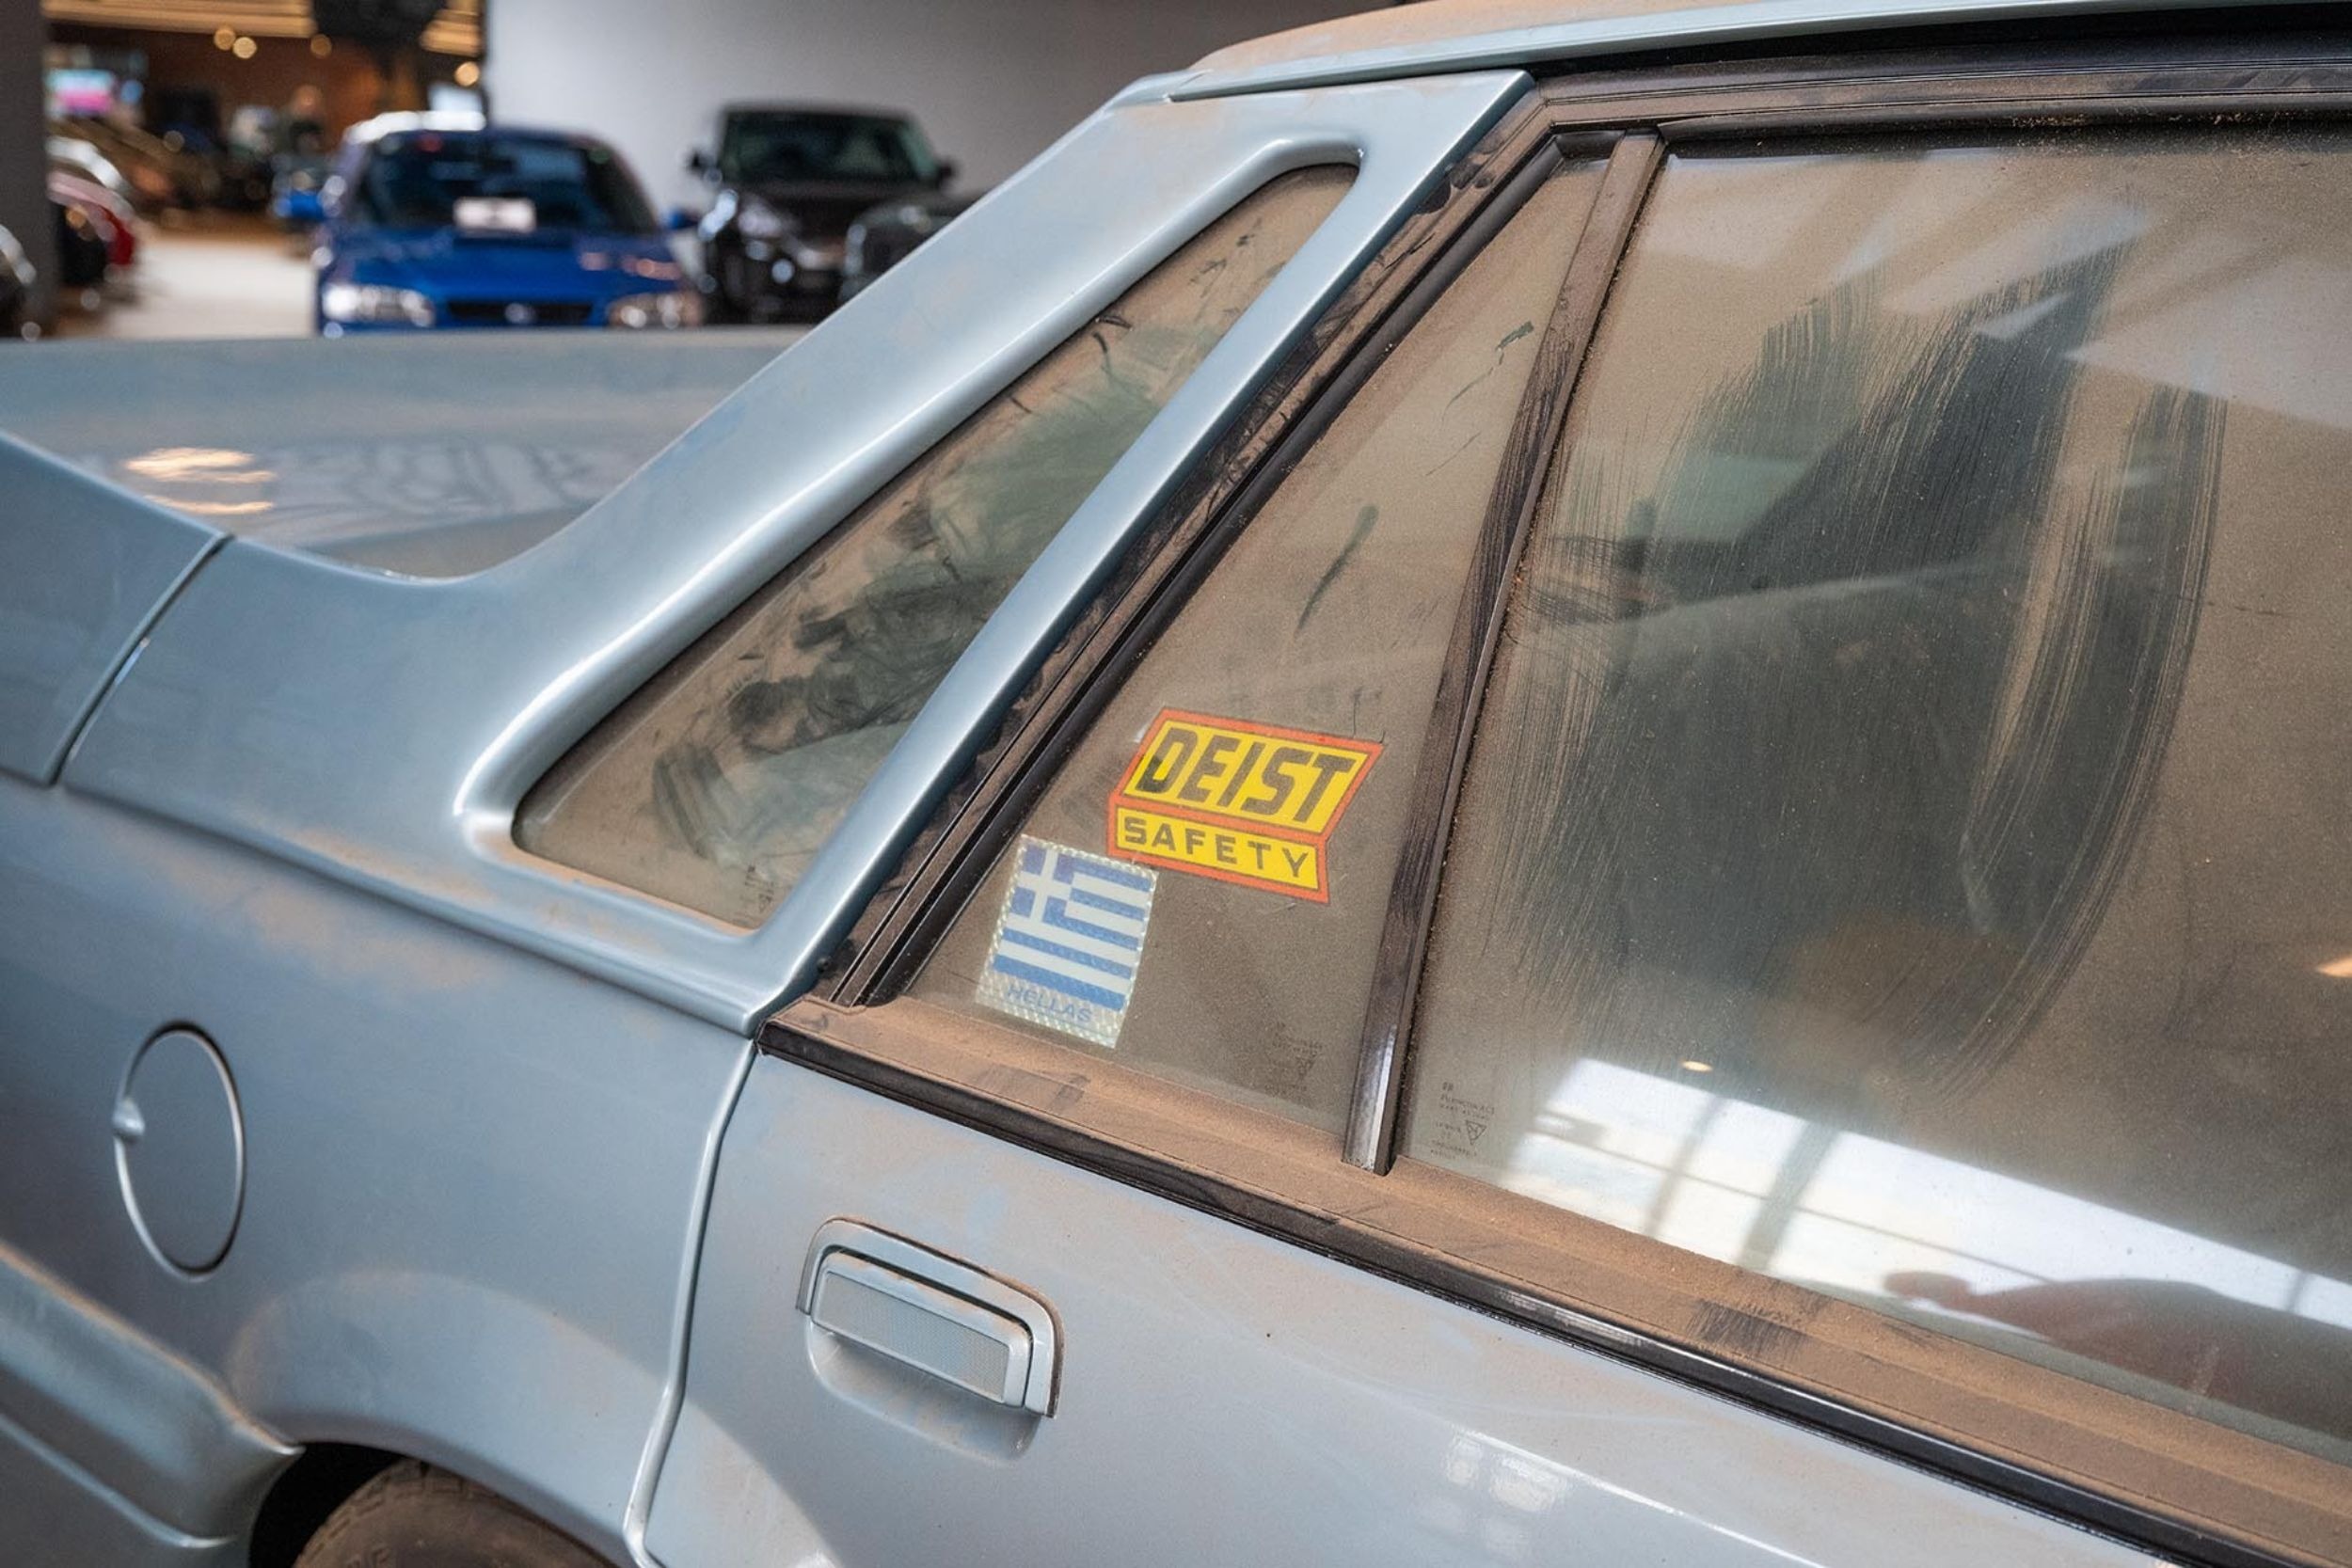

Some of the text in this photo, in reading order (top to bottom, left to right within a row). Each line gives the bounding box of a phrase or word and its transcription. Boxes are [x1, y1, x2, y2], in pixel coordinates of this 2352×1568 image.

[1134, 726, 1358, 823] DEIST
[1123, 816, 1310, 879] SAFETY
[1007, 984, 1093, 1023] HELLAS
